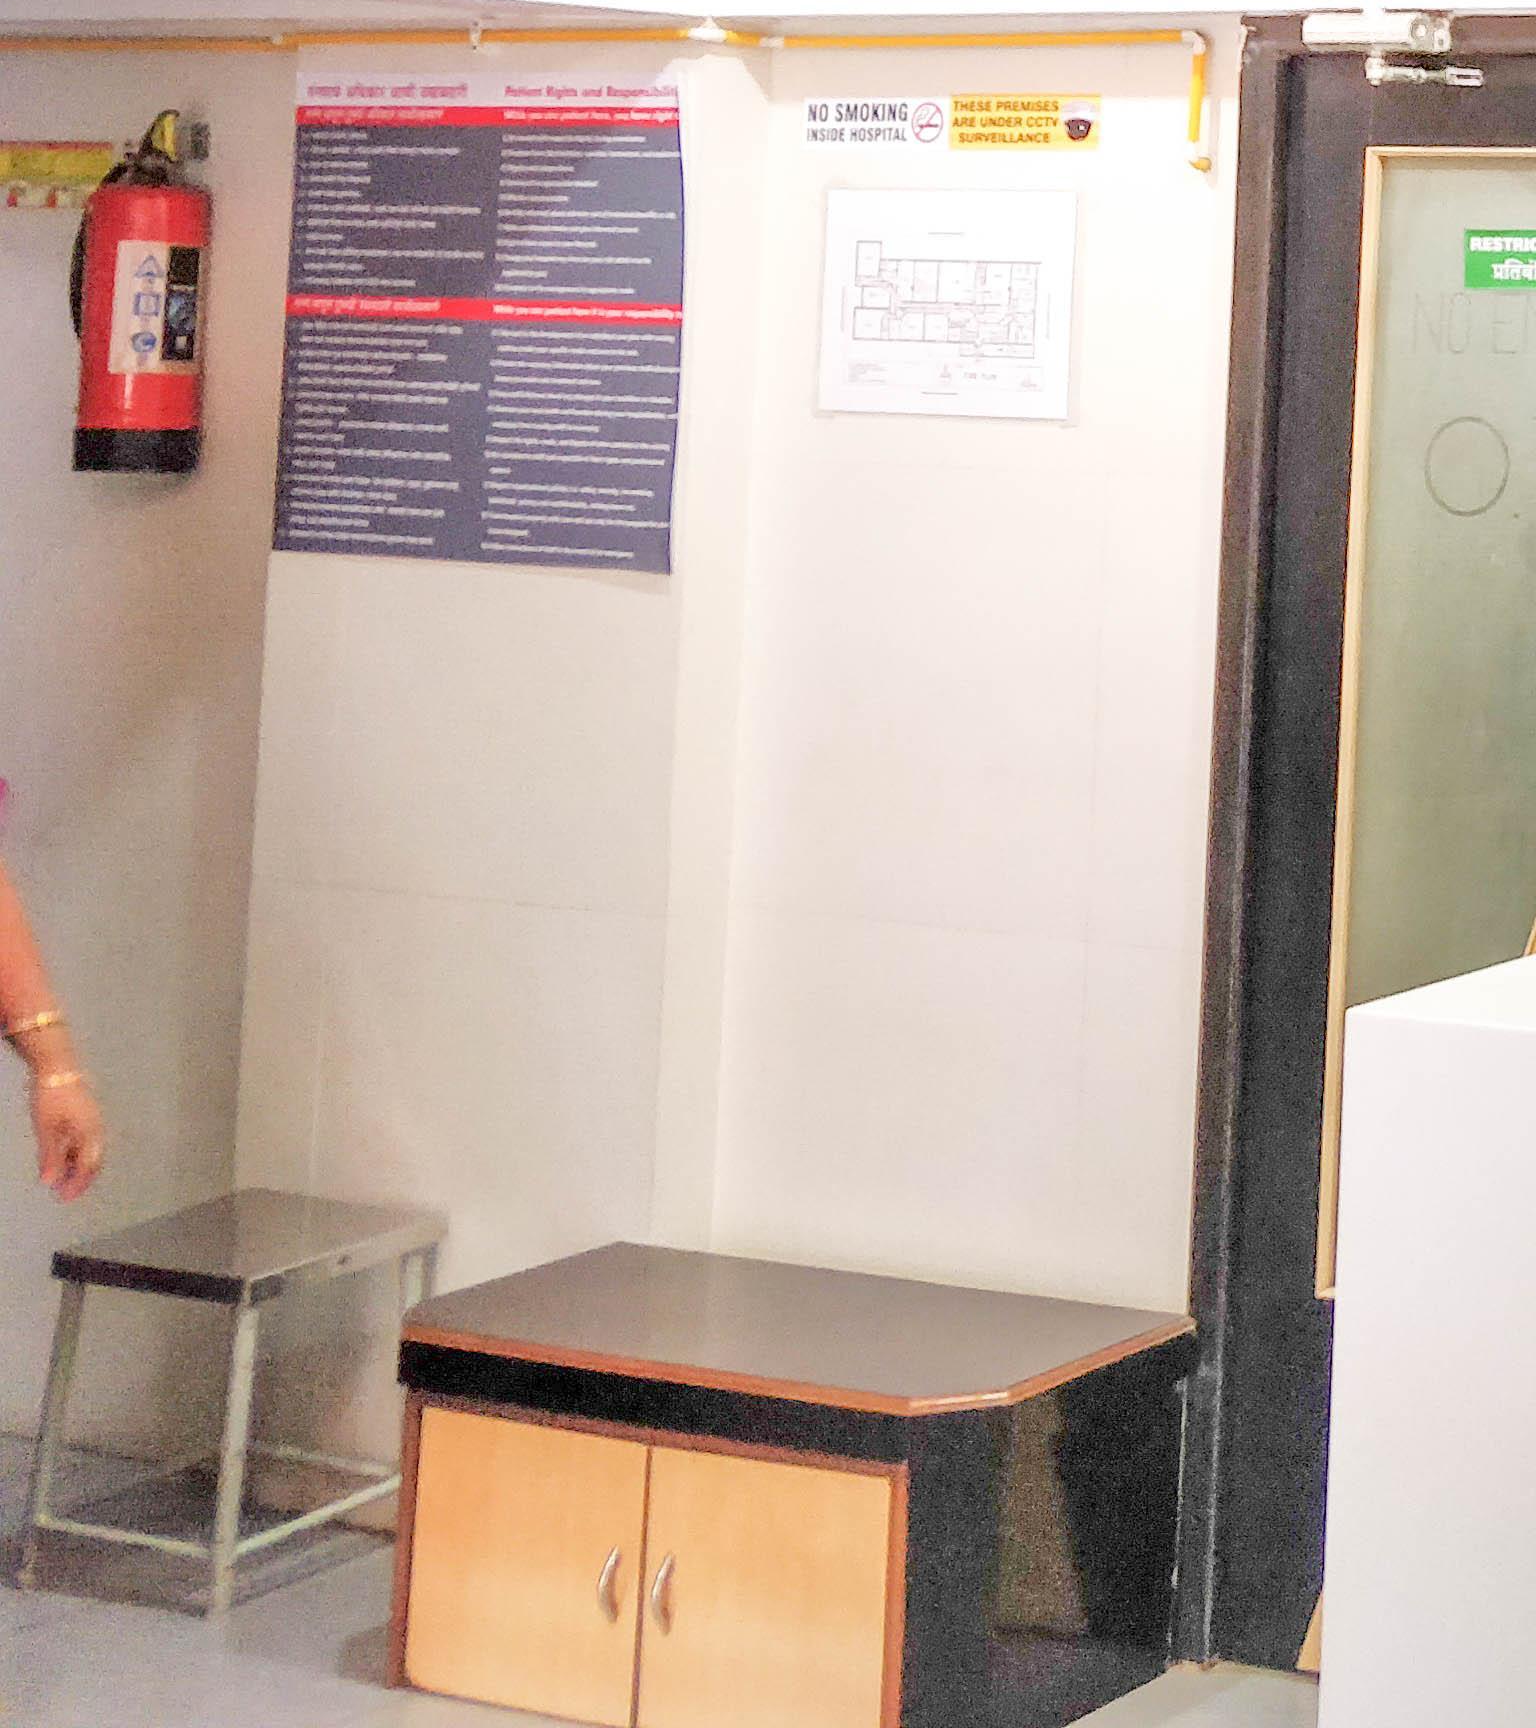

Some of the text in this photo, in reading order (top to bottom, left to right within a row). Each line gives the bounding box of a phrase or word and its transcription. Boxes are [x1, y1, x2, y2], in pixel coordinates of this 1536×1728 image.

[807, 103, 908, 122] NO SMOKING
[953, 100, 1060, 113] THESE PREMISES
[952, 115, 1059, 129] ARE UNDER CCTV
[807, 127, 908, 143] INSIDE HOSPITAL
[958, 131, 1051, 145] SURVEILLANCE
